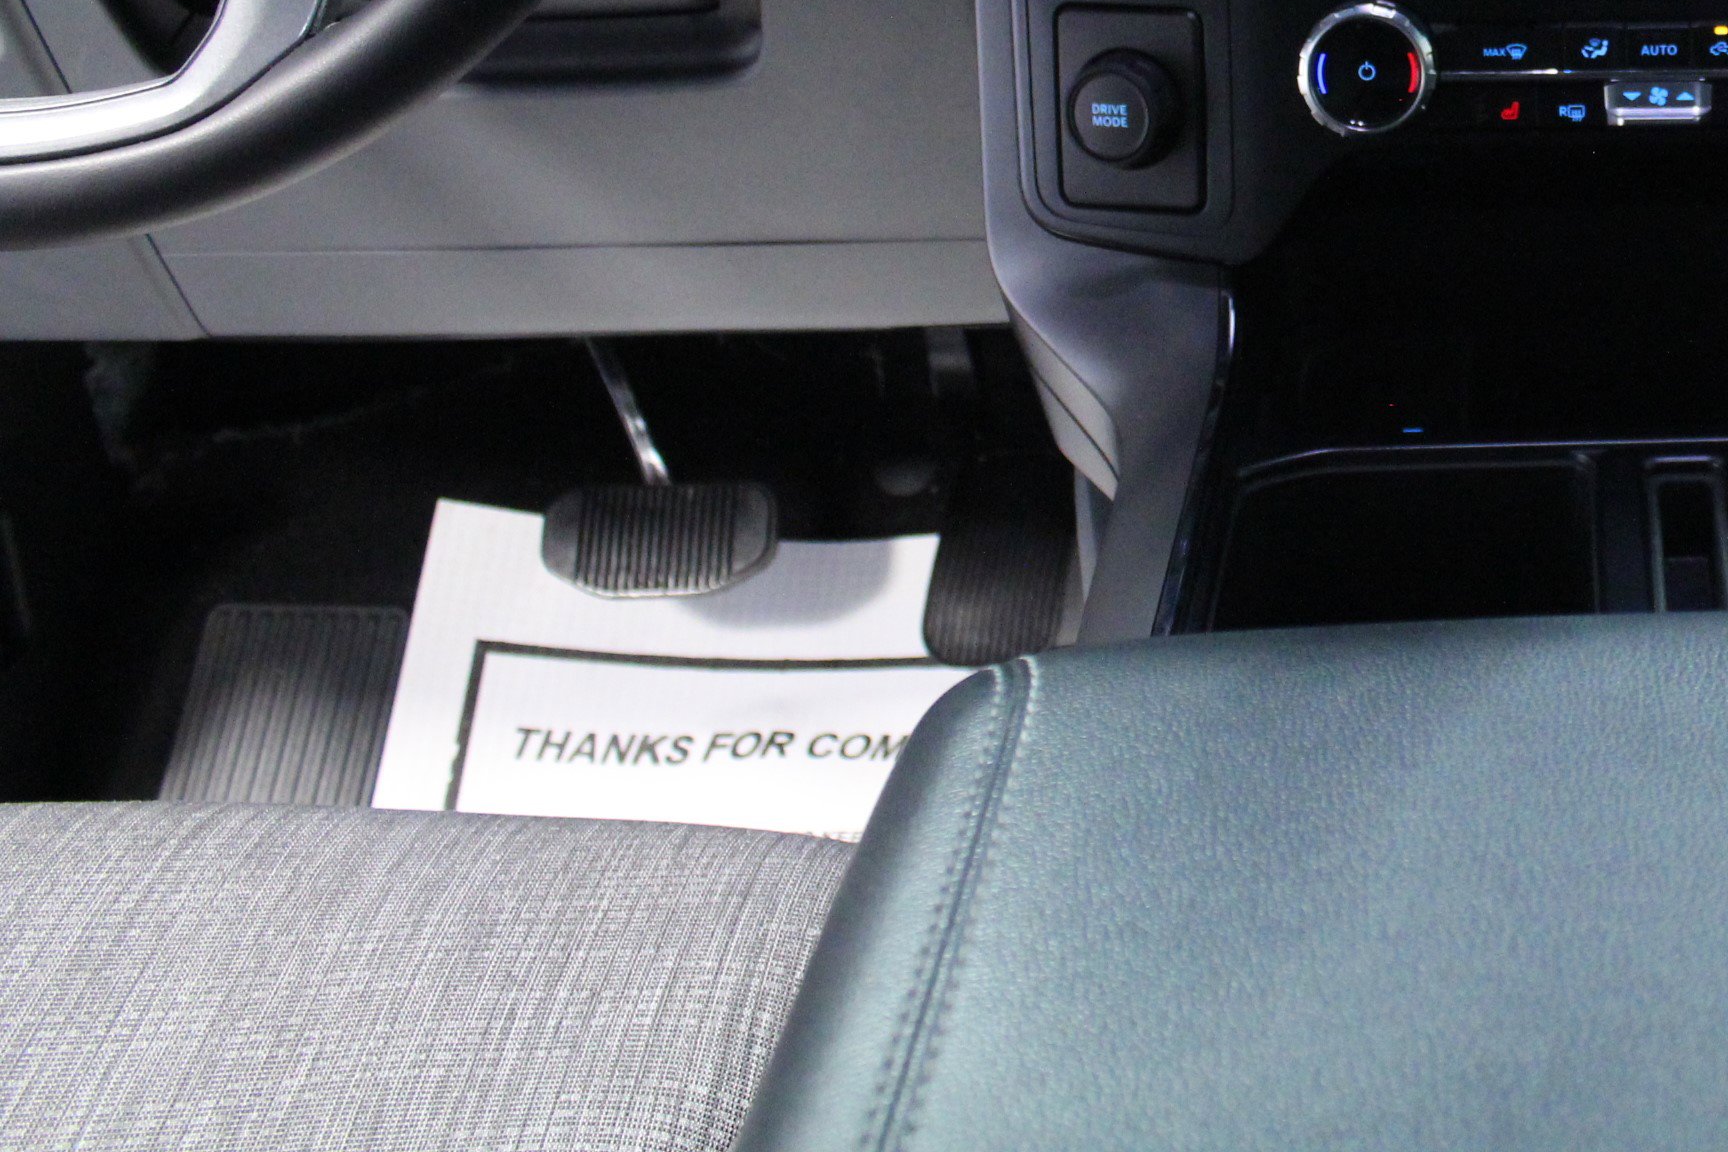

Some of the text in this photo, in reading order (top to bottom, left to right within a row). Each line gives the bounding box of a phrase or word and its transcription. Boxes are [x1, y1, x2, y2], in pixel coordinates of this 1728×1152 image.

[1483, 47, 1506, 58] MAX
[1640, 44, 1678, 57] AUTO
[1091, 102, 1128, 116] DRIVE
[1091, 115, 1129, 128] MODE
[514, 726, 911, 767] THANKS FOR COM
